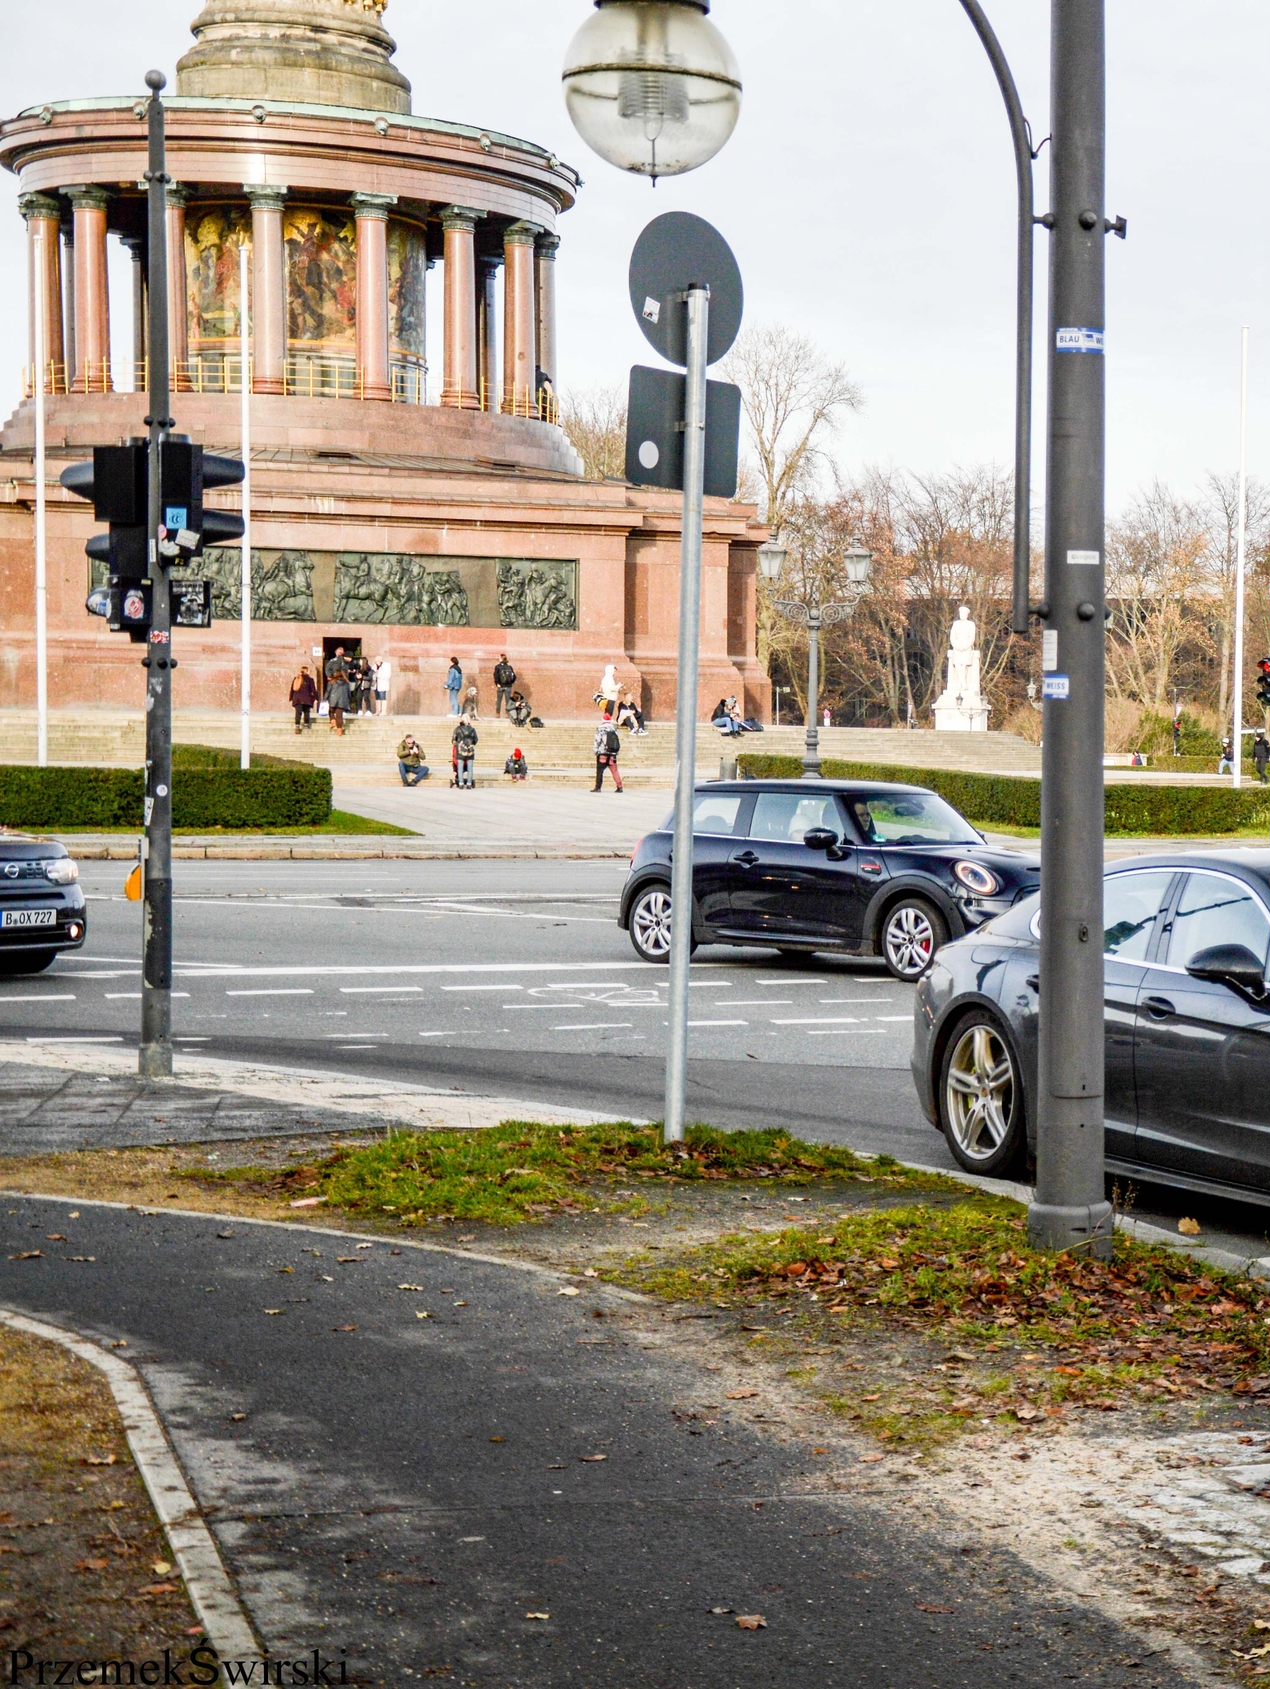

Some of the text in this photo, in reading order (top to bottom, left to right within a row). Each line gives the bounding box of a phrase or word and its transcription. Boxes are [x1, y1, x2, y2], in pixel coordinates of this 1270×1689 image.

[1059, 335, 1080, 343] BLAU
[1046, 682, 1066, 690] WEISS
[5, 911, 53, 925] B OX 727
